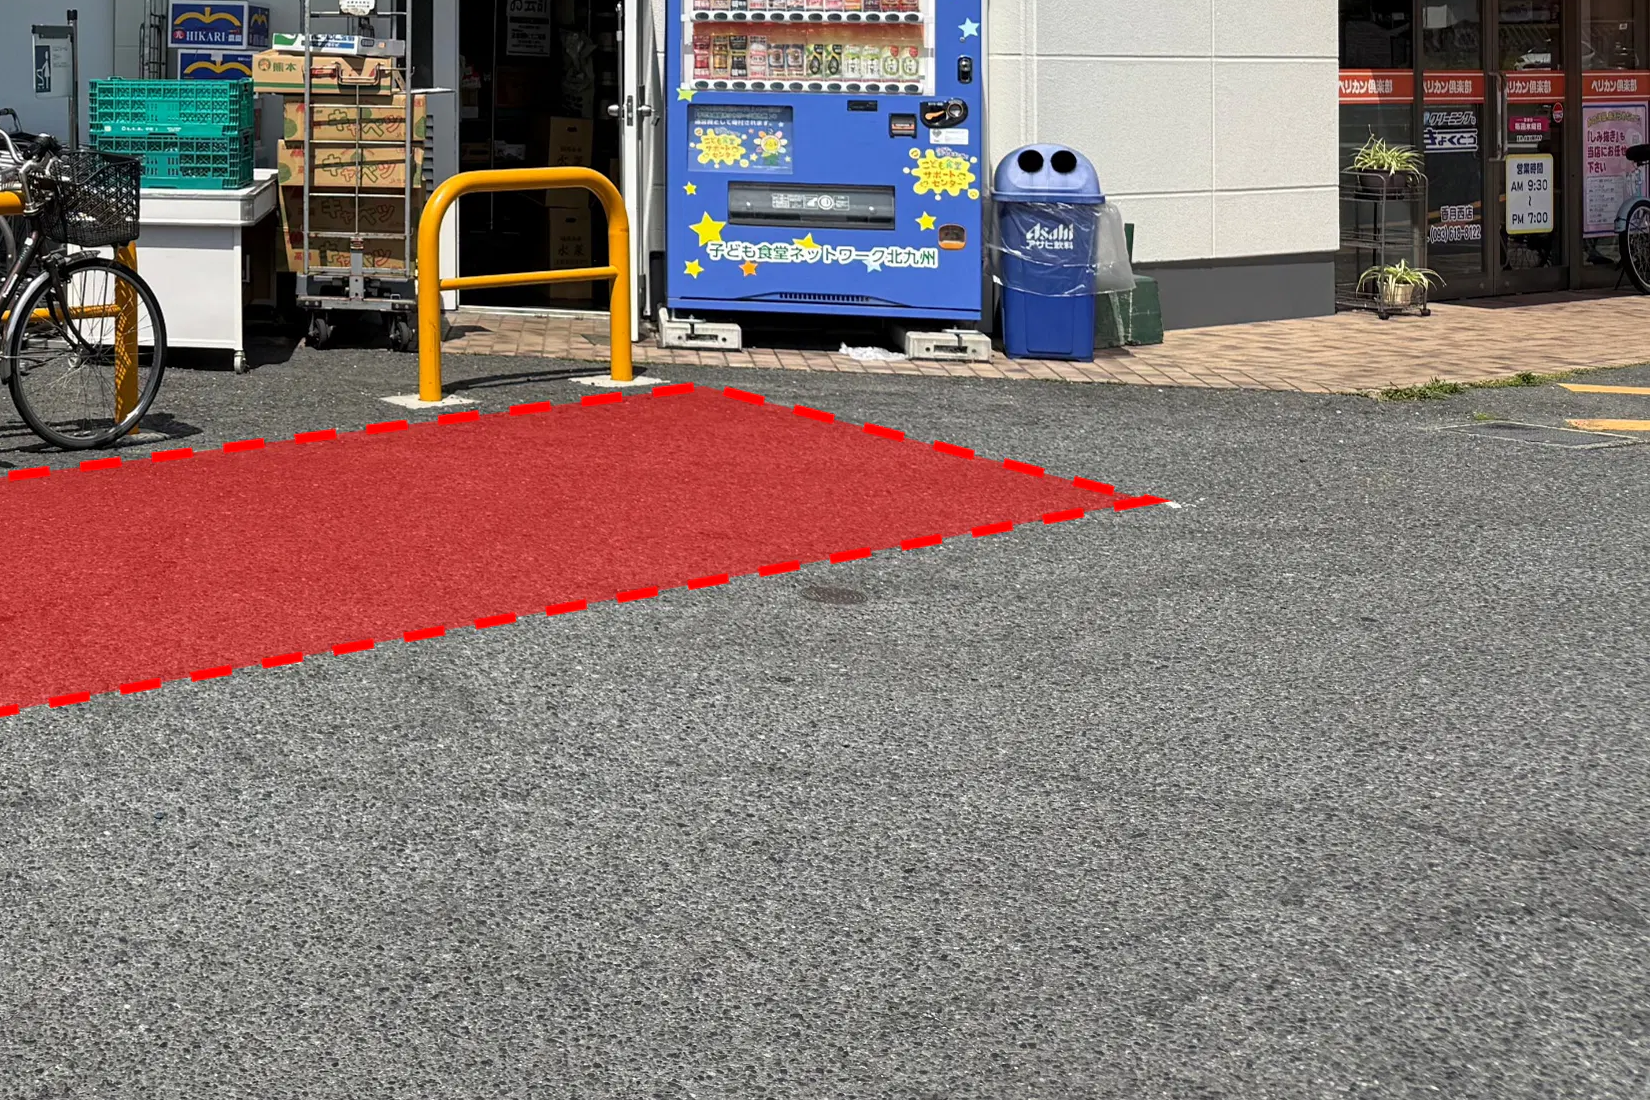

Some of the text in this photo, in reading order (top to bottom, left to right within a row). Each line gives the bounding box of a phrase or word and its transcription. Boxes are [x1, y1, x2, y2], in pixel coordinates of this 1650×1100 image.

[186, 31, 226, 42] HIKARI
[272, 62, 297, 72] 熊本
[1591, 79, 1637, 93] ペリカン倶楽部
[327, 109, 403, 137] キャベツ
[322, 153, 397, 184] キャベツ
[921, 159, 963, 171] こども食堂
[1516, 162, 1544, 175] 営業時間
[1587, 161, 1607, 174] 下さい
[923, 171, 956, 179] サポート
[932, 180, 963, 188] センター
[1511, 179, 1548, 192] AM 9:30
[321, 197, 395, 226] キャベツ
[1512, 212, 1549, 225] PM 7:00
[1025, 222, 1074, 241] Asahi
[1025, 240, 1074, 250] アサヒ飲料
[708, 241, 938, 267] 子ども食堂ネットワーク北九州
